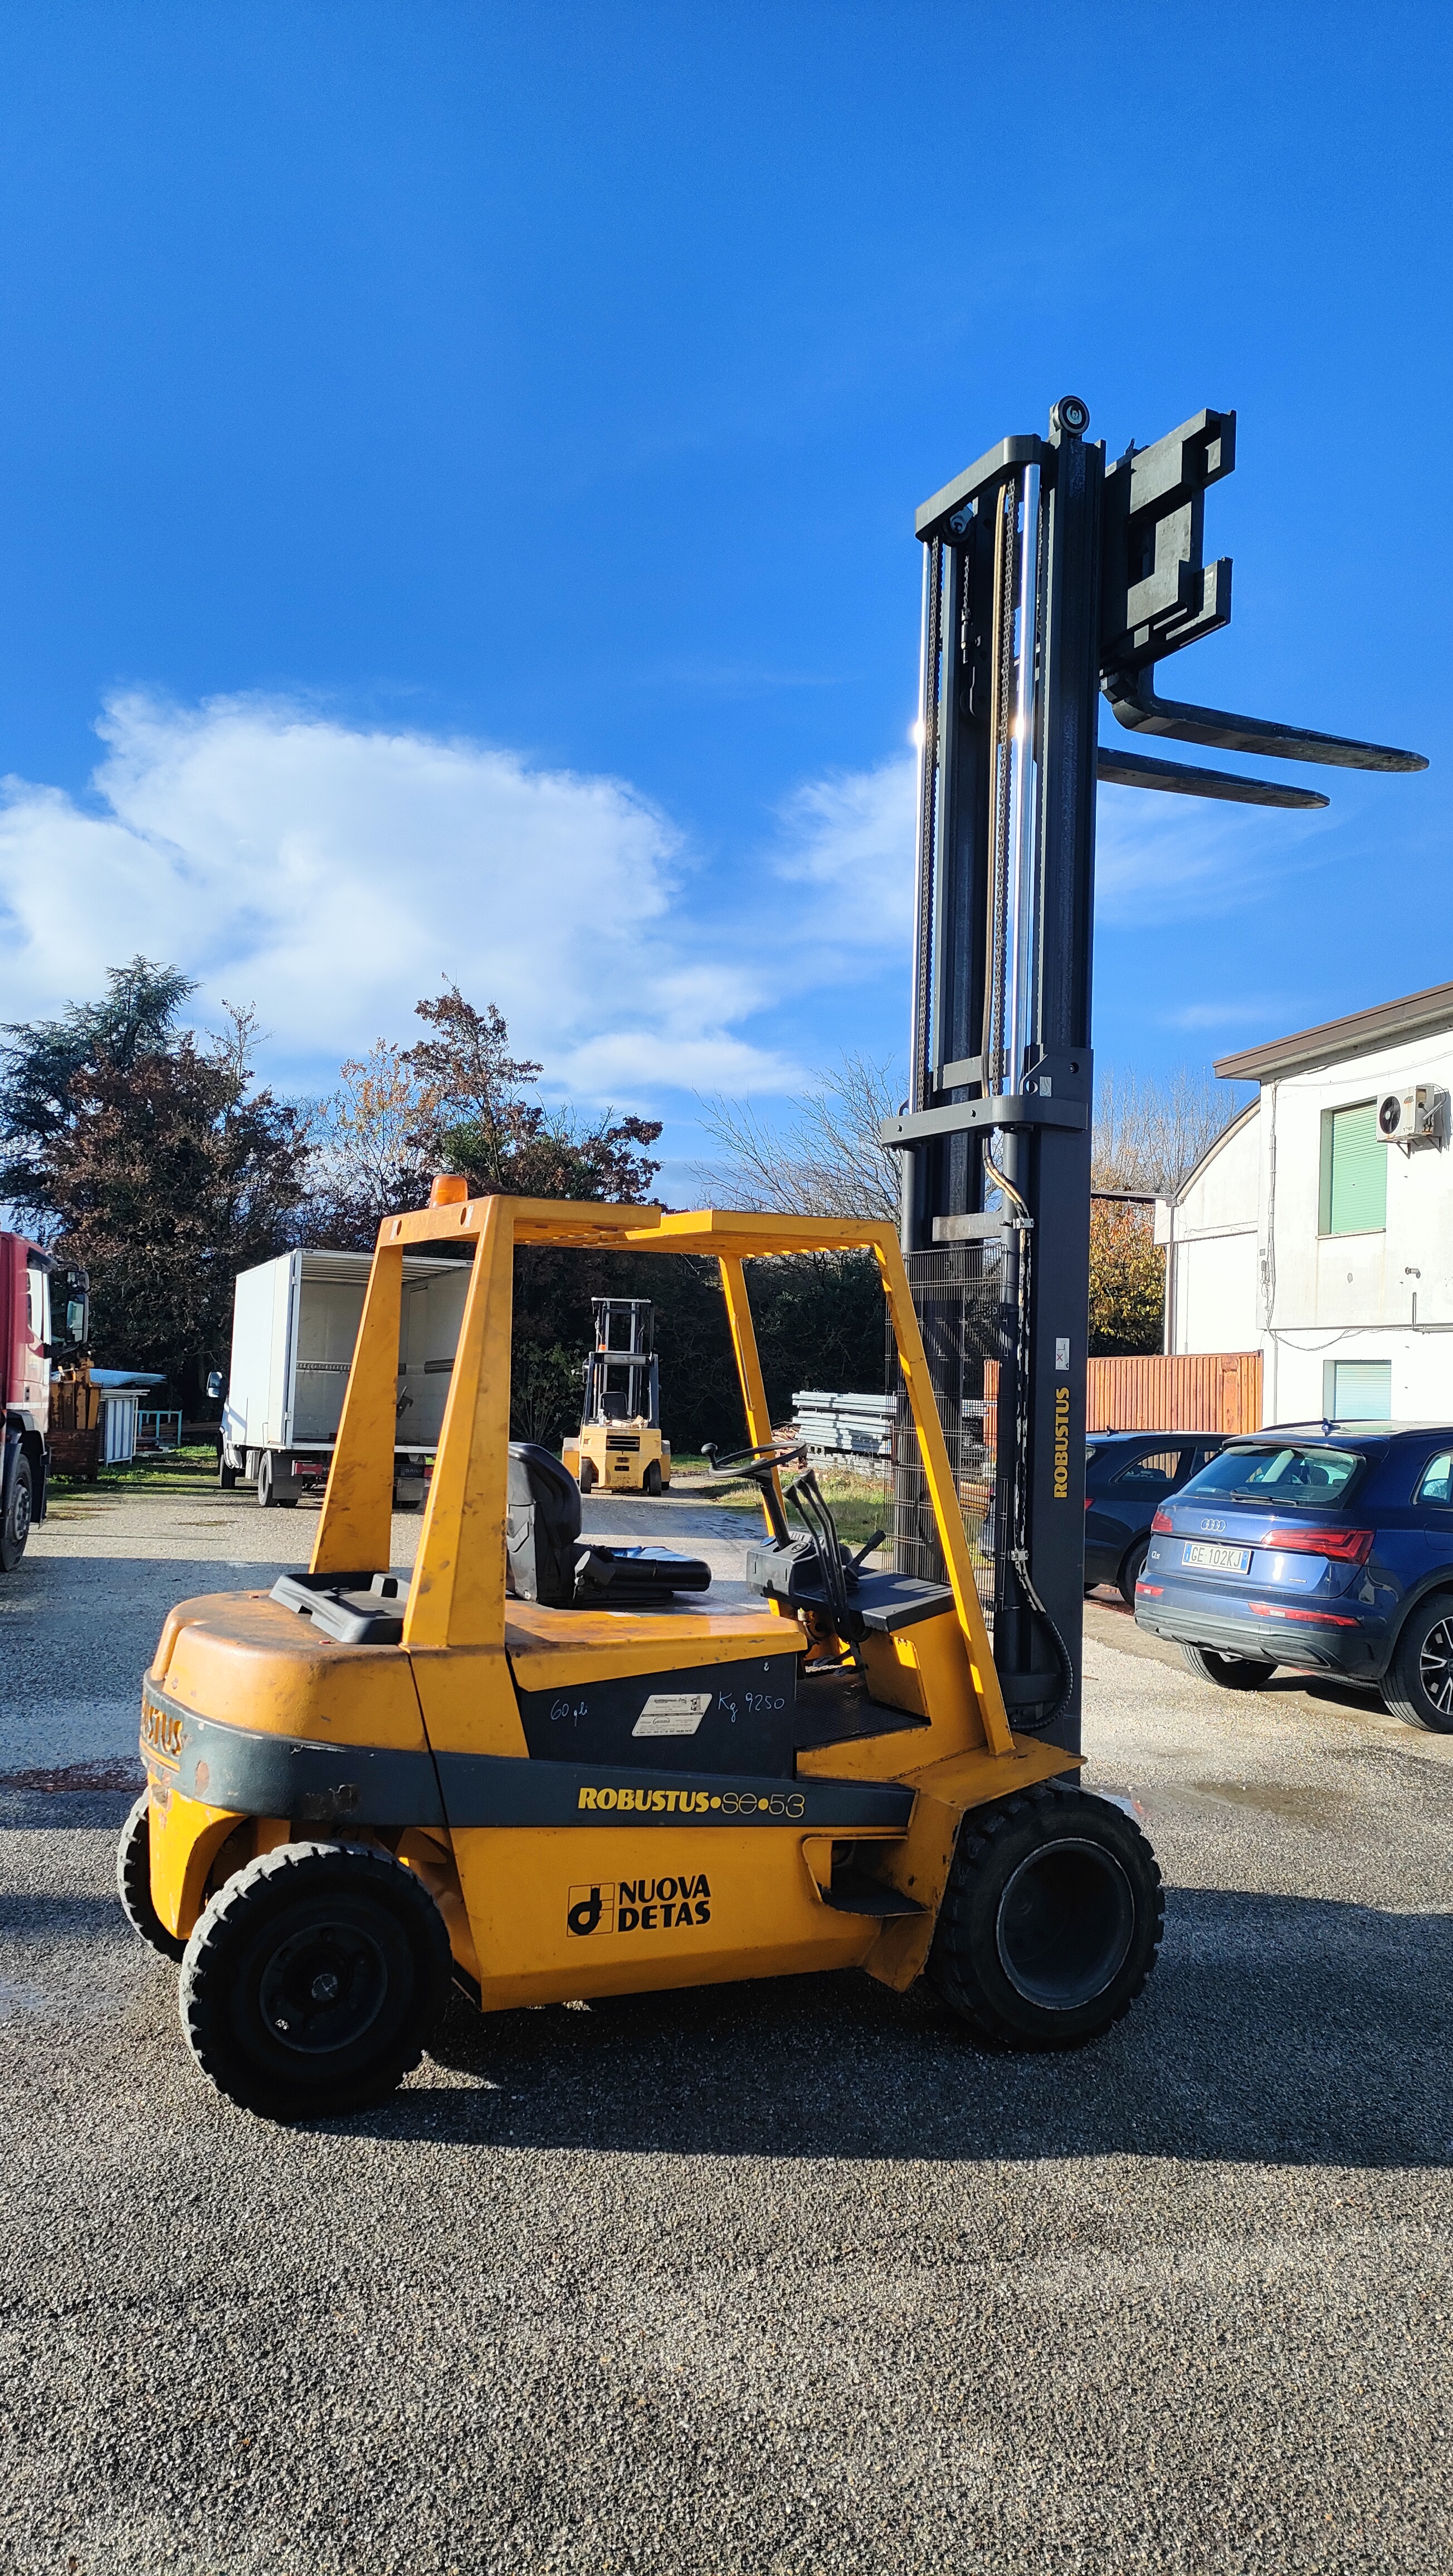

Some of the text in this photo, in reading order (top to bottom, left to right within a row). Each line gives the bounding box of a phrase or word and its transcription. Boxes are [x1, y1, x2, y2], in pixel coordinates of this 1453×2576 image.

[1054, 1387, 1070, 1498] ROBUSTUS
[550, 1699, 569, 1720] 60
[718, 1691, 785, 1723] Kg 9250
[619, 1874, 712, 1906] NUOVA
[618, 1900, 711, 1933] DETAS
